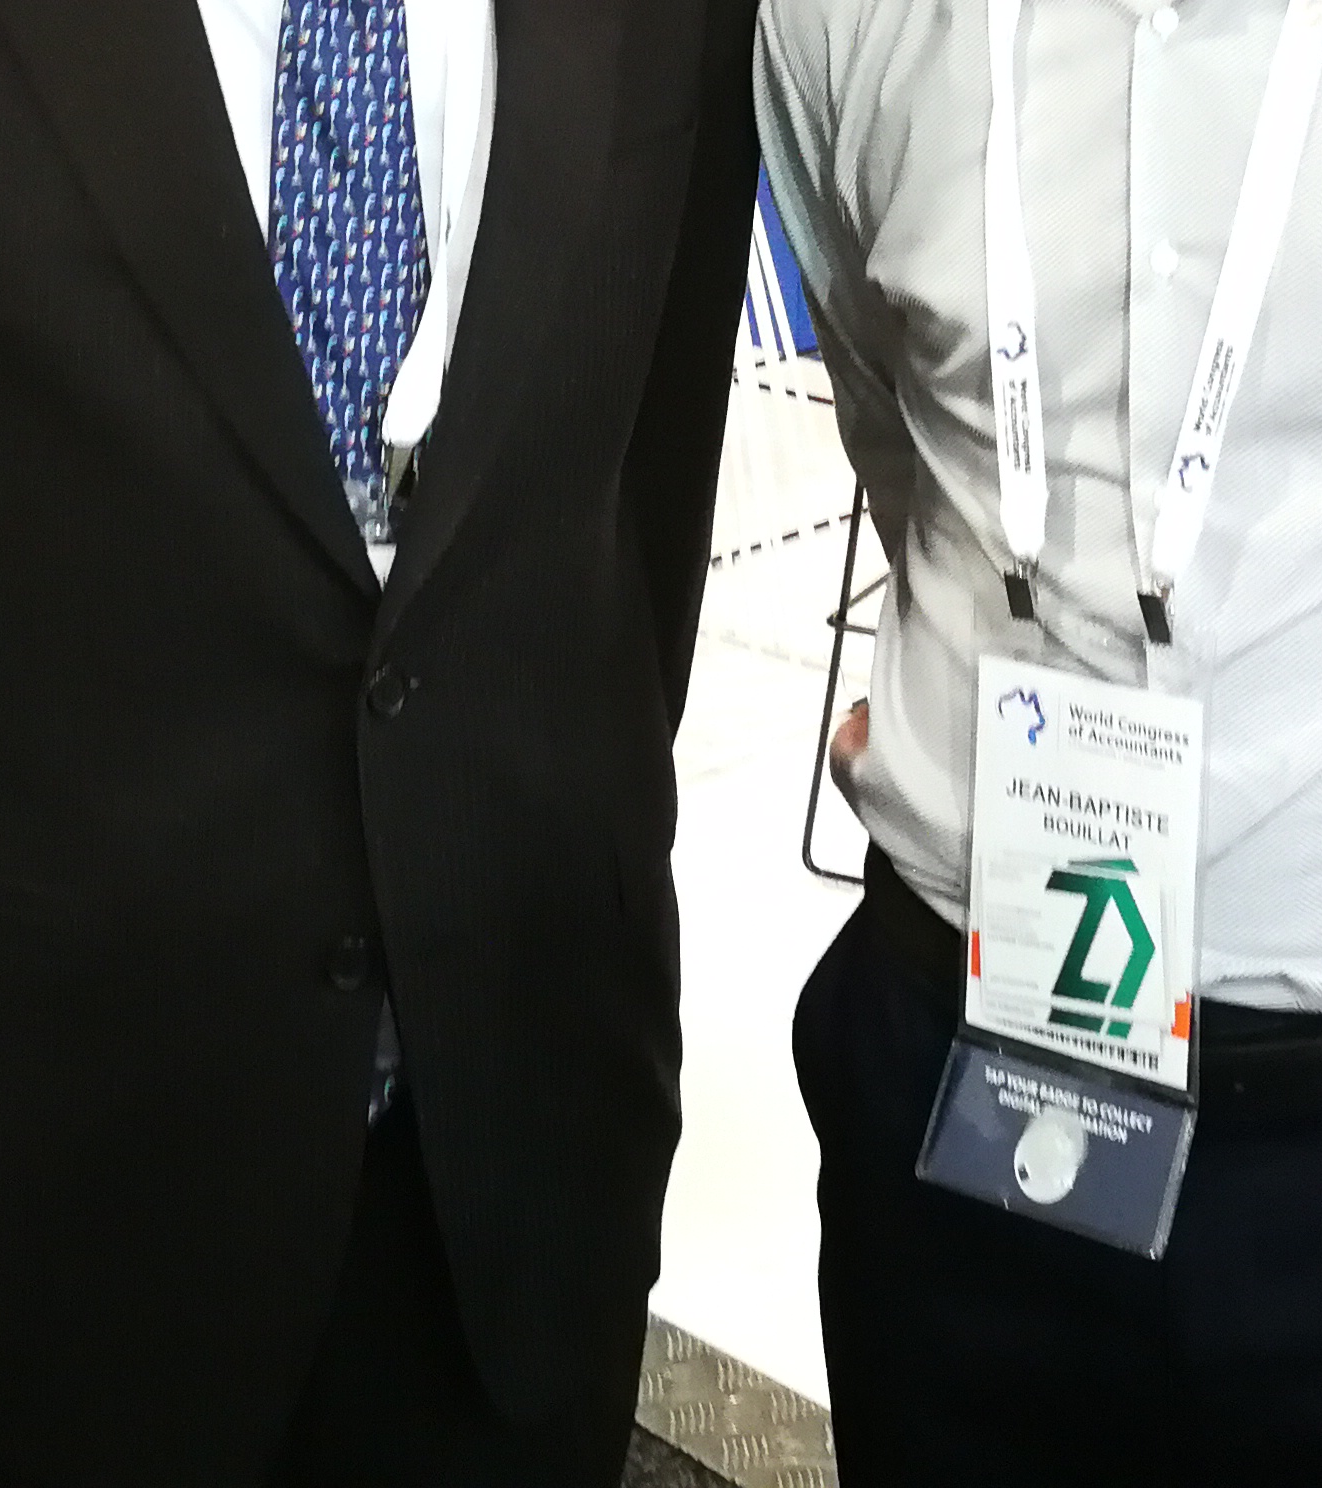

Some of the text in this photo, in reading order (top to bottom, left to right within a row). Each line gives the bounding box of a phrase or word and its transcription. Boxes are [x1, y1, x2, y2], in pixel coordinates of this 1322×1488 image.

[1068, 702, 1190, 748] World Congress
[1068, 722, 1084, 741] of
[1087, 728, 1183, 764] Accountants
[1006, 776, 1170, 836] JEAN-BAPTISTE
[1043, 812, 1132, 854] BOUILLAT
